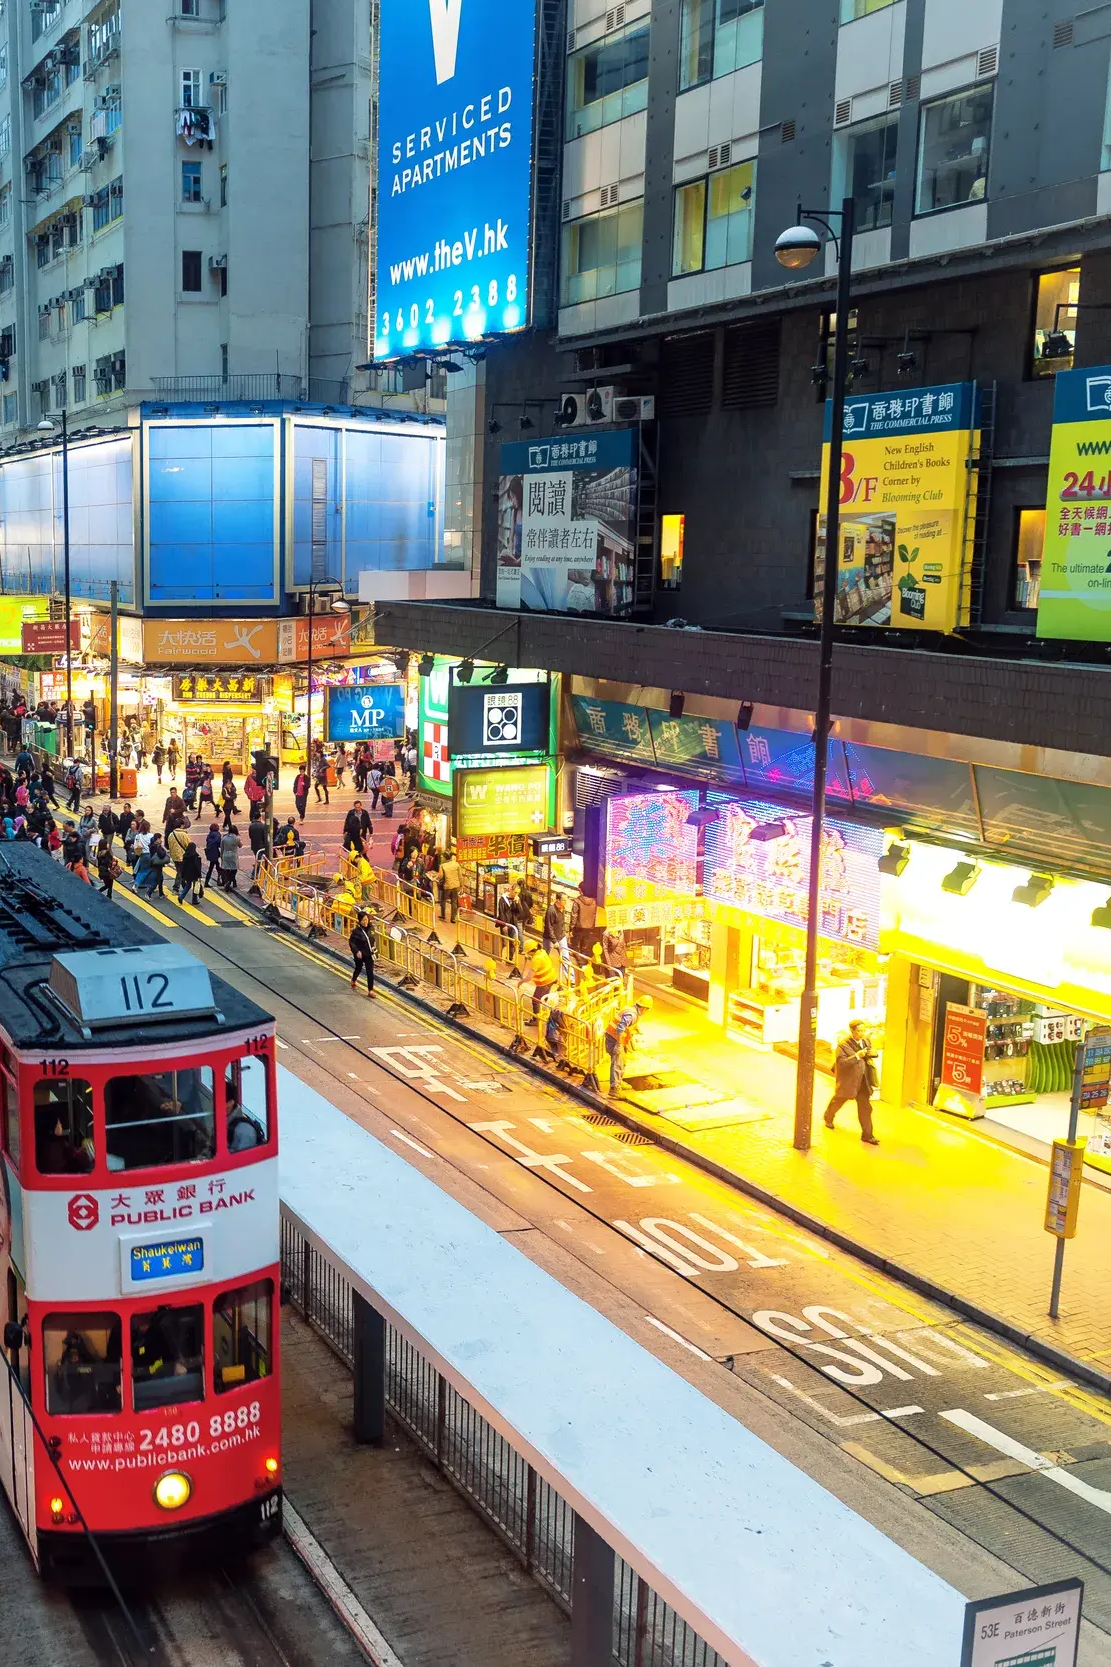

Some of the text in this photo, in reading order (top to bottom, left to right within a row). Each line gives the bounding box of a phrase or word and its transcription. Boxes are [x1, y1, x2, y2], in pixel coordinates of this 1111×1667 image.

[392, 86, 512, 165] SERVICED
[391, 122, 512, 197] APARTMENTS
[389, 218, 509, 286] www.theV.hk
[382, 274, 517, 336] 3602 2388
[871, 391, 954, 420] 商務印書館
[870, 413, 952, 430] THE COMMERCIAL PRESS
[550, 439, 598, 459] 商務印書館
[884, 443, 934, 455] New English
[883, 457, 950, 471] Children's Books
[882, 475, 921, 487] Corner by
[528, 480, 567, 518] 閱讀
[882, 489, 943, 504] Blooming Club
[1059, 505, 1111, 520] 全天候網
[526, 527, 594, 549] 常伴讀者左右
[1051, 562, 1105, 574] The ultimate
[158, 630, 217, 646] 大快活
[158, 647, 217, 655] Fairwood
[349, 709, 385, 728] MP
[121, 973, 174, 1011] 112
[244, 1034, 268, 1053] 112
[40, 1059, 70, 1076] 112
[110, 1188, 255, 1227] PUBLIC BANK
[133, 1240, 201, 1260] Shaukeiwan
[139, 1400, 261, 1451] 2480 8888
[68, 1425, 261, 1472] www.publicbank.com.hk
[260, 1494, 279, 1521] 112
[1013, 1602, 1066, 1625] 百德新街
[980, 1622, 1001, 1640] 53E
[1003, 1616, 1072, 1640] Paterson Street
